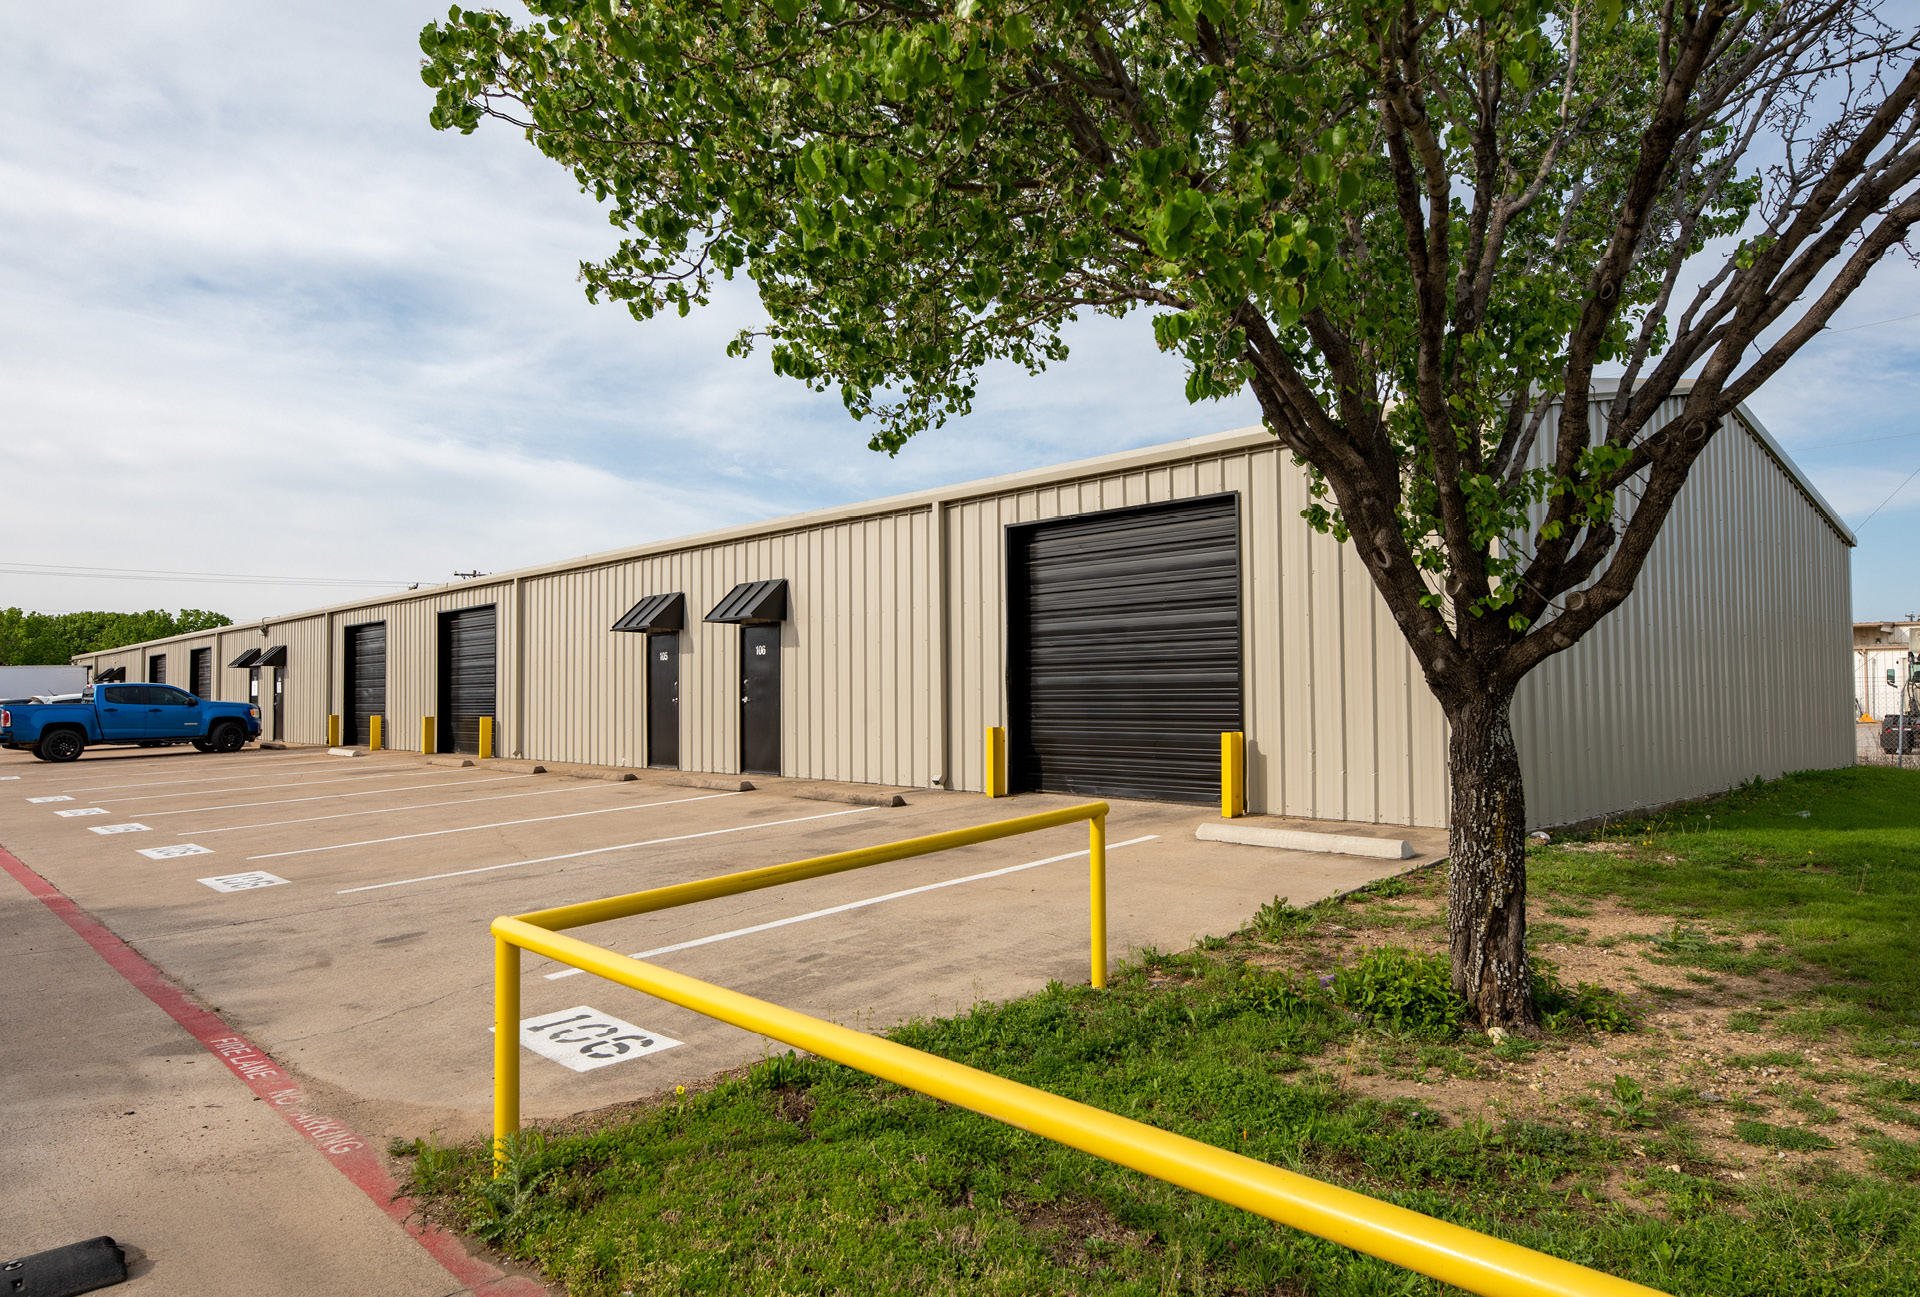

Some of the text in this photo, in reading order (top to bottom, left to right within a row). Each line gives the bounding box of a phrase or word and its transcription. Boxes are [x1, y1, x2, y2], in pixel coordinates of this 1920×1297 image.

[755, 645, 766, 655] 106
[525, 1013, 655, 1059] 106
[210, 1037, 364, 1154] FIRE LANE NO ARKING
